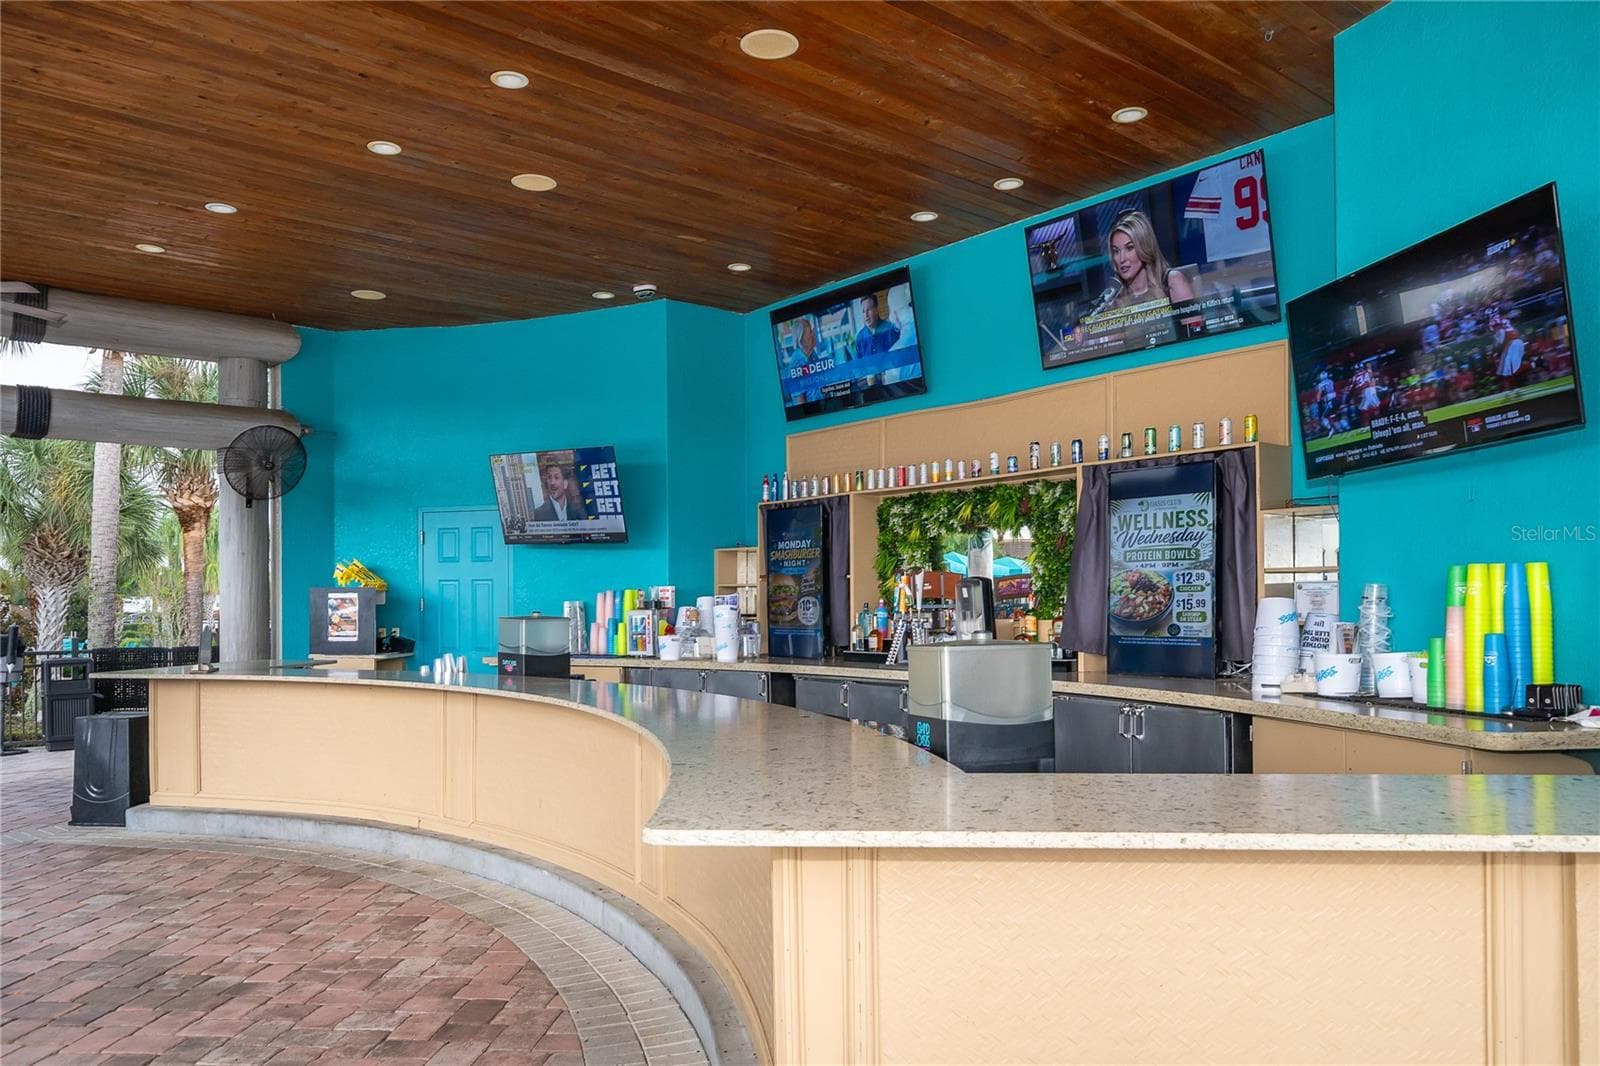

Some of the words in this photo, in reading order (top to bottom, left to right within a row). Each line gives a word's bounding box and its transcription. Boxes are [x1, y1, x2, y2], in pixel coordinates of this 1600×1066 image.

[590, 462, 617, 479] GET
[593, 480, 619, 496] GET
[595, 497, 622, 513] GET
[1117, 508, 1209, 532] WELLNESS
[778, 539, 812, 550] MONDAY
[1115, 527, 1208, 548] Wednesday
[770, 547, 821, 561] SMASHBURGER
[1126, 550, 1162, 561] PROTEIN
[1164, 549, 1197, 559] BOWLS
[1176, 572, 1206, 584] $12.99
[1176, 598, 1206, 611] $15.99
